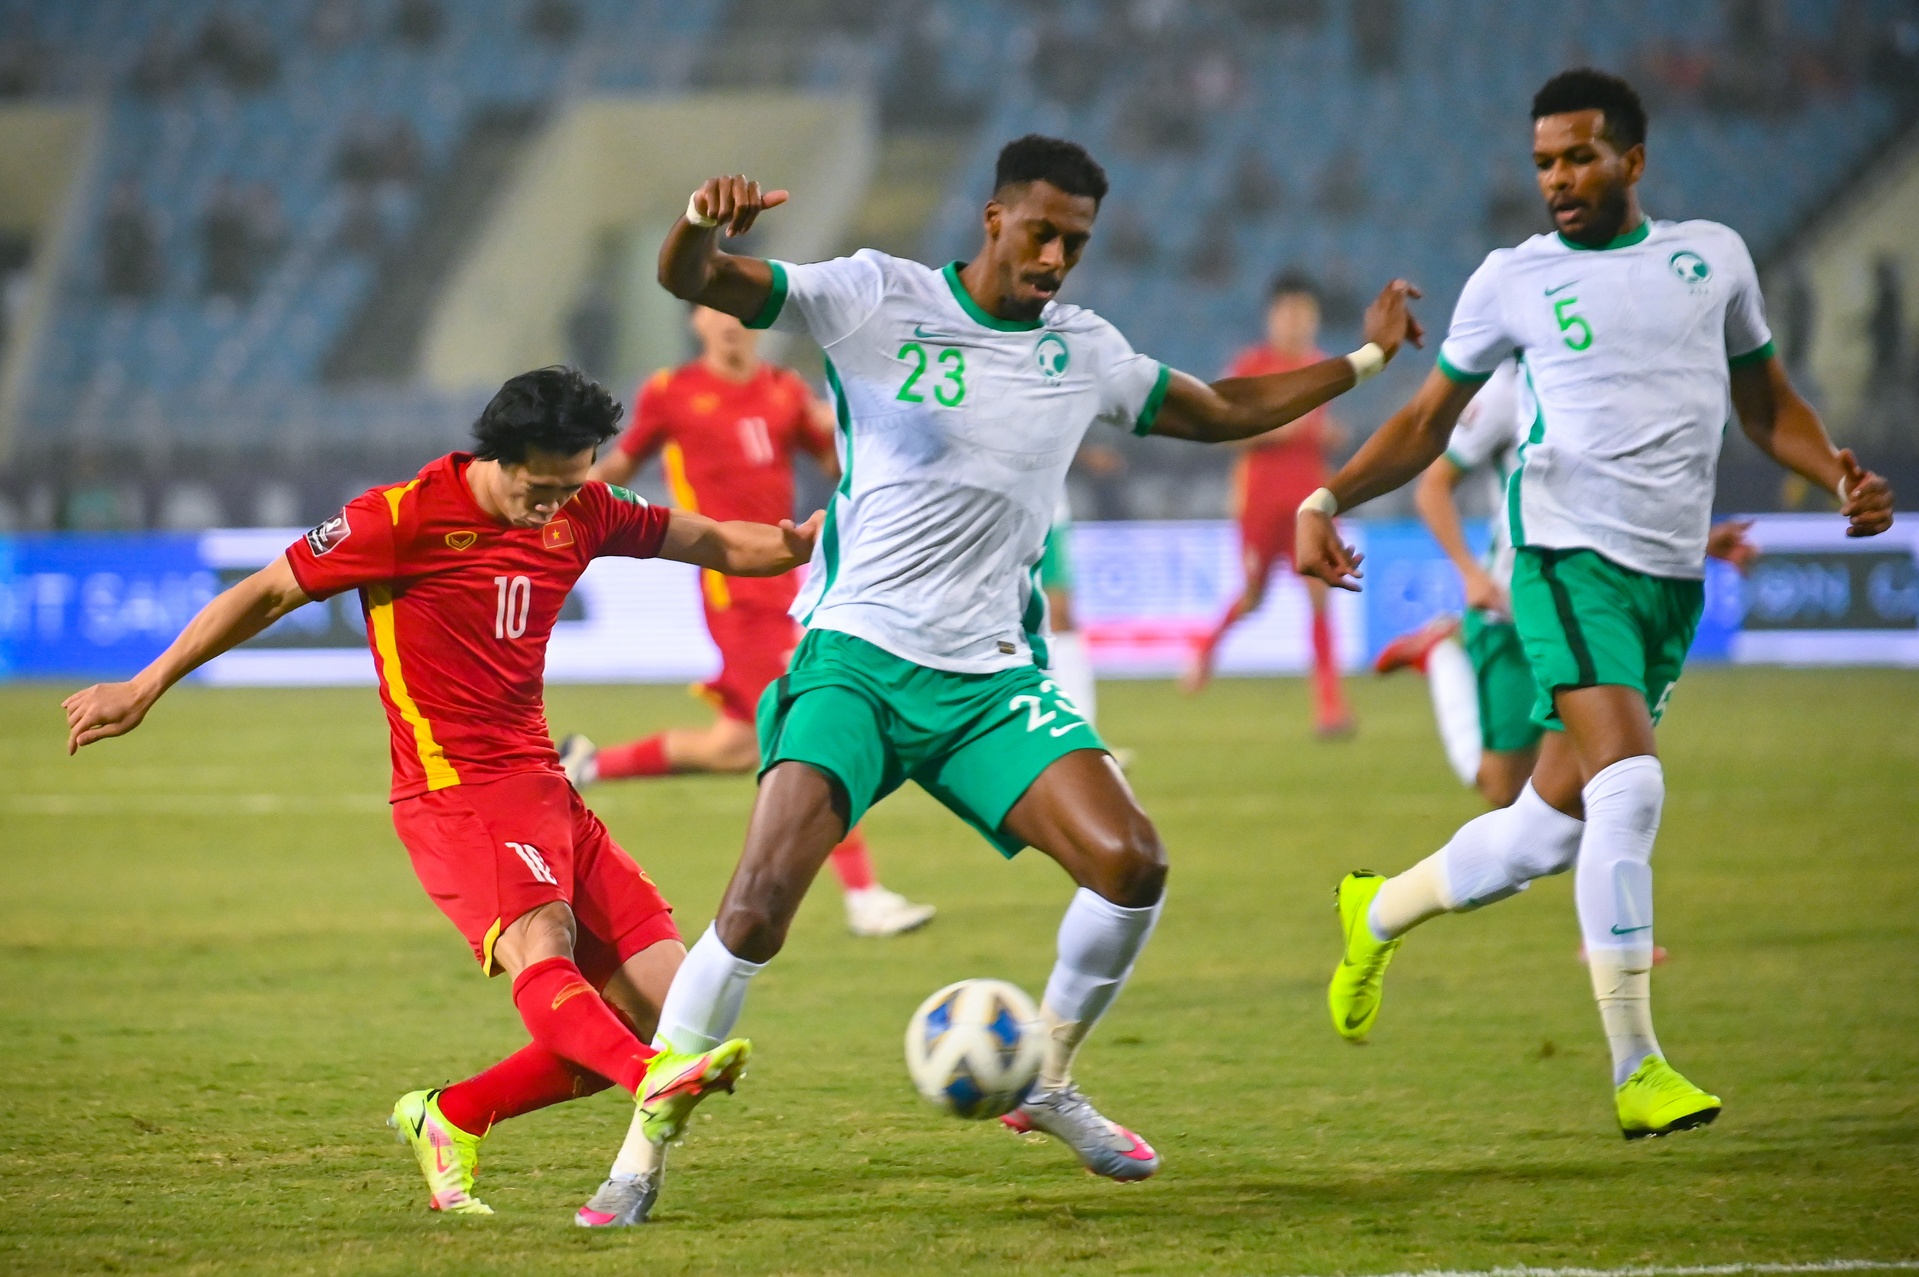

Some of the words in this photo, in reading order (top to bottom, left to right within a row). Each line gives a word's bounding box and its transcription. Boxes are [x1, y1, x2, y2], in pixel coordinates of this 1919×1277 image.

[1553, 296, 1593, 351] 5
[896, 342, 966, 407] 23
[494, 575, 531, 640] 10
